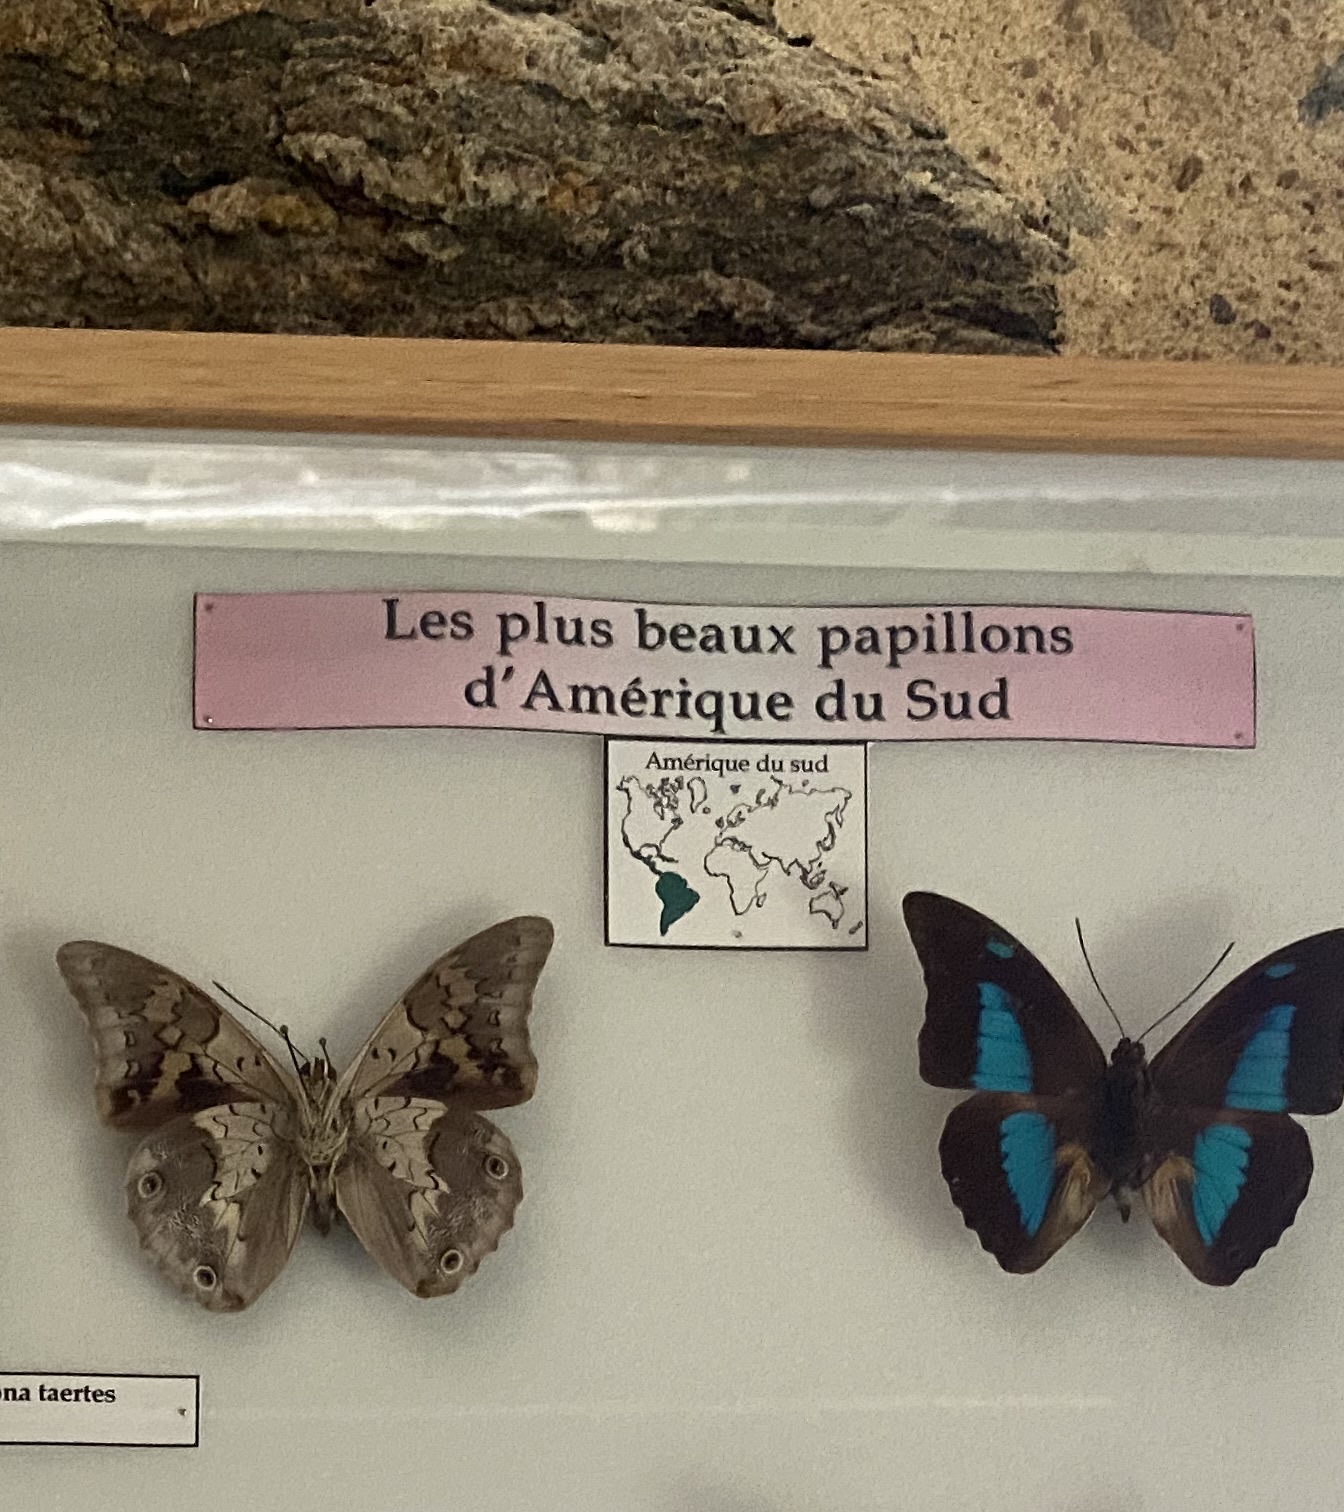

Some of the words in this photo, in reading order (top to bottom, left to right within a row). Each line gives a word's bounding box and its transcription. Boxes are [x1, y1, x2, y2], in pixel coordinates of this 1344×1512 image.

[381, 597, 475, 642] Les
[496, 601, 615, 656] plus
[633, 606, 797, 656] beaux
[815, 609, 1075, 669] papillons
[815, 678, 886, 723] du
[906, 677, 1011, 722] Sud
[645, 751, 750, 778] Amérique
[756, 753, 784, 773] du
[790, 754, 829, 773] sud
[38, 1384, 117, 1404] taertes
